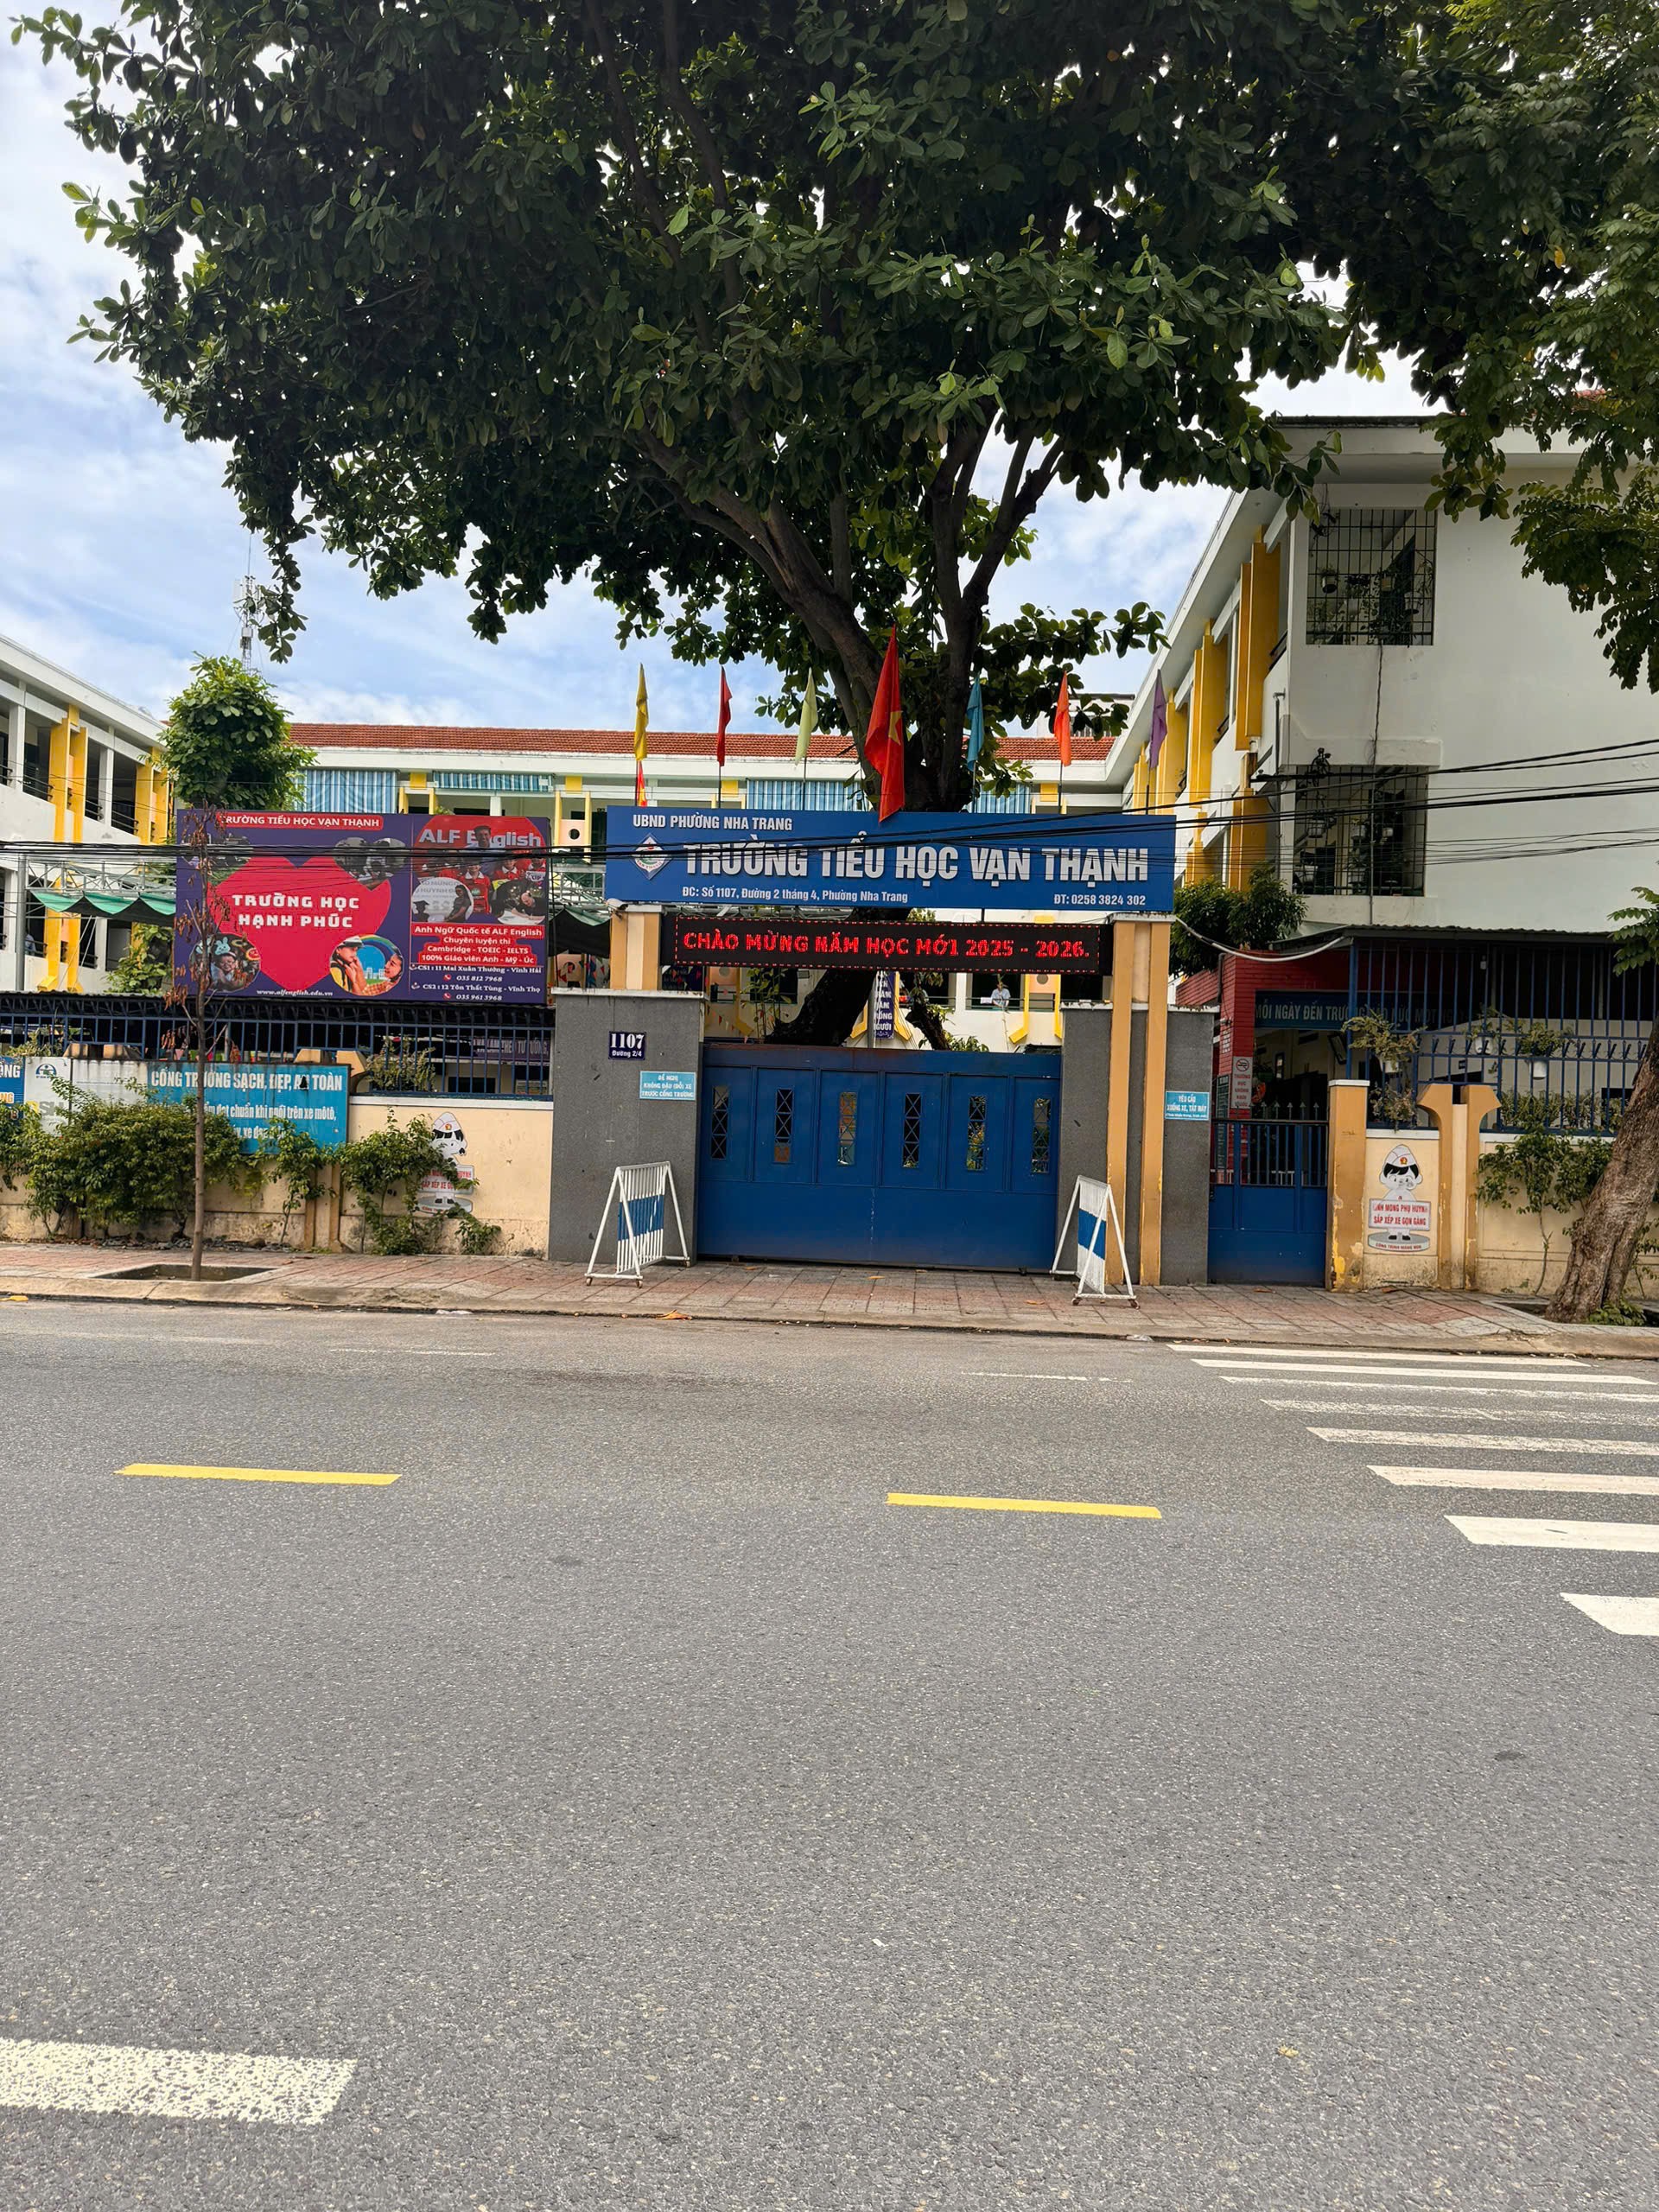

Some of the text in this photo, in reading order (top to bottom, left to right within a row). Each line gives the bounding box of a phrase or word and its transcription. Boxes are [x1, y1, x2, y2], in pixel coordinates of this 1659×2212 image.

[267, 814, 290, 824] TIỂU
[293, 817, 315, 827] HỌC
[318, 818, 340, 827] VẠN
[343, 818, 379, 828] THẠNH
[632, 812, 792, 830] UBND PHƯỜNG NHA TRANG
[419, 829, 541, 849] ALF Eglish
[683, 830, 1148, 888] TRƯỜNG TIỂU HỌC VẠN THẠNH
[682, 883, 908, 903] ĐC: Số 1107, Đường 2 tháng 4, Phường Nha Trang
[1053, 893, 1146, 906] ĐT: 0258 3824 302
[232, 892, 359, 912] TRƯỜNG HỌC
[238, 912, 353, 929] HẠNH PHÚC
[435, 926, 454, 935] Ngữ
[456, 926, 479, 935] Quốc
[510, 929, 542, 938] English
[427, 945, 471, 954] Cambridge
[443, 937, 474, 945] Chuyên
[475, 938, 498, 946] luyện
[683, 928, 739, 950] CHÀO
[746, 930, 809, 951] MỪNG
[815, 931, 859, 953] NĂM
[867, 937, 909, 957] HỌC
[965, 939, 1014, 957] 2025
[1036, 940, 1090, 958] 2026.
[1274, 1001, 1300, 1020] NGÀY
[1303, 1000, 1323, 1020] ĐẾN
[610, 1033, 645, 1049] 1107
[612, 1049, 631, 1058] Đường
[151, 1069, 182, 1088] CỔNG
[233, 1072, 267, 1092] SẠCH,
[270, 1073, 292, 1092] ĐẸP,
[312, 1072, 342, 1091] TOÀN
[230, 1103, 253, 1118] chuẩn
[287, 1107, 303, 1120] trên
[304, 1109, 314, 1120] xe
[1401, 1205, 1411, 1213] PHỤ
[1374, 1214, 1383, 1224] SẮP
[1384, 1215, 1394, 1224] XẾP
[1402, 1217, 1412, 1226] GỌN
[1413, 1217, 1426, 1225] GÀNG
